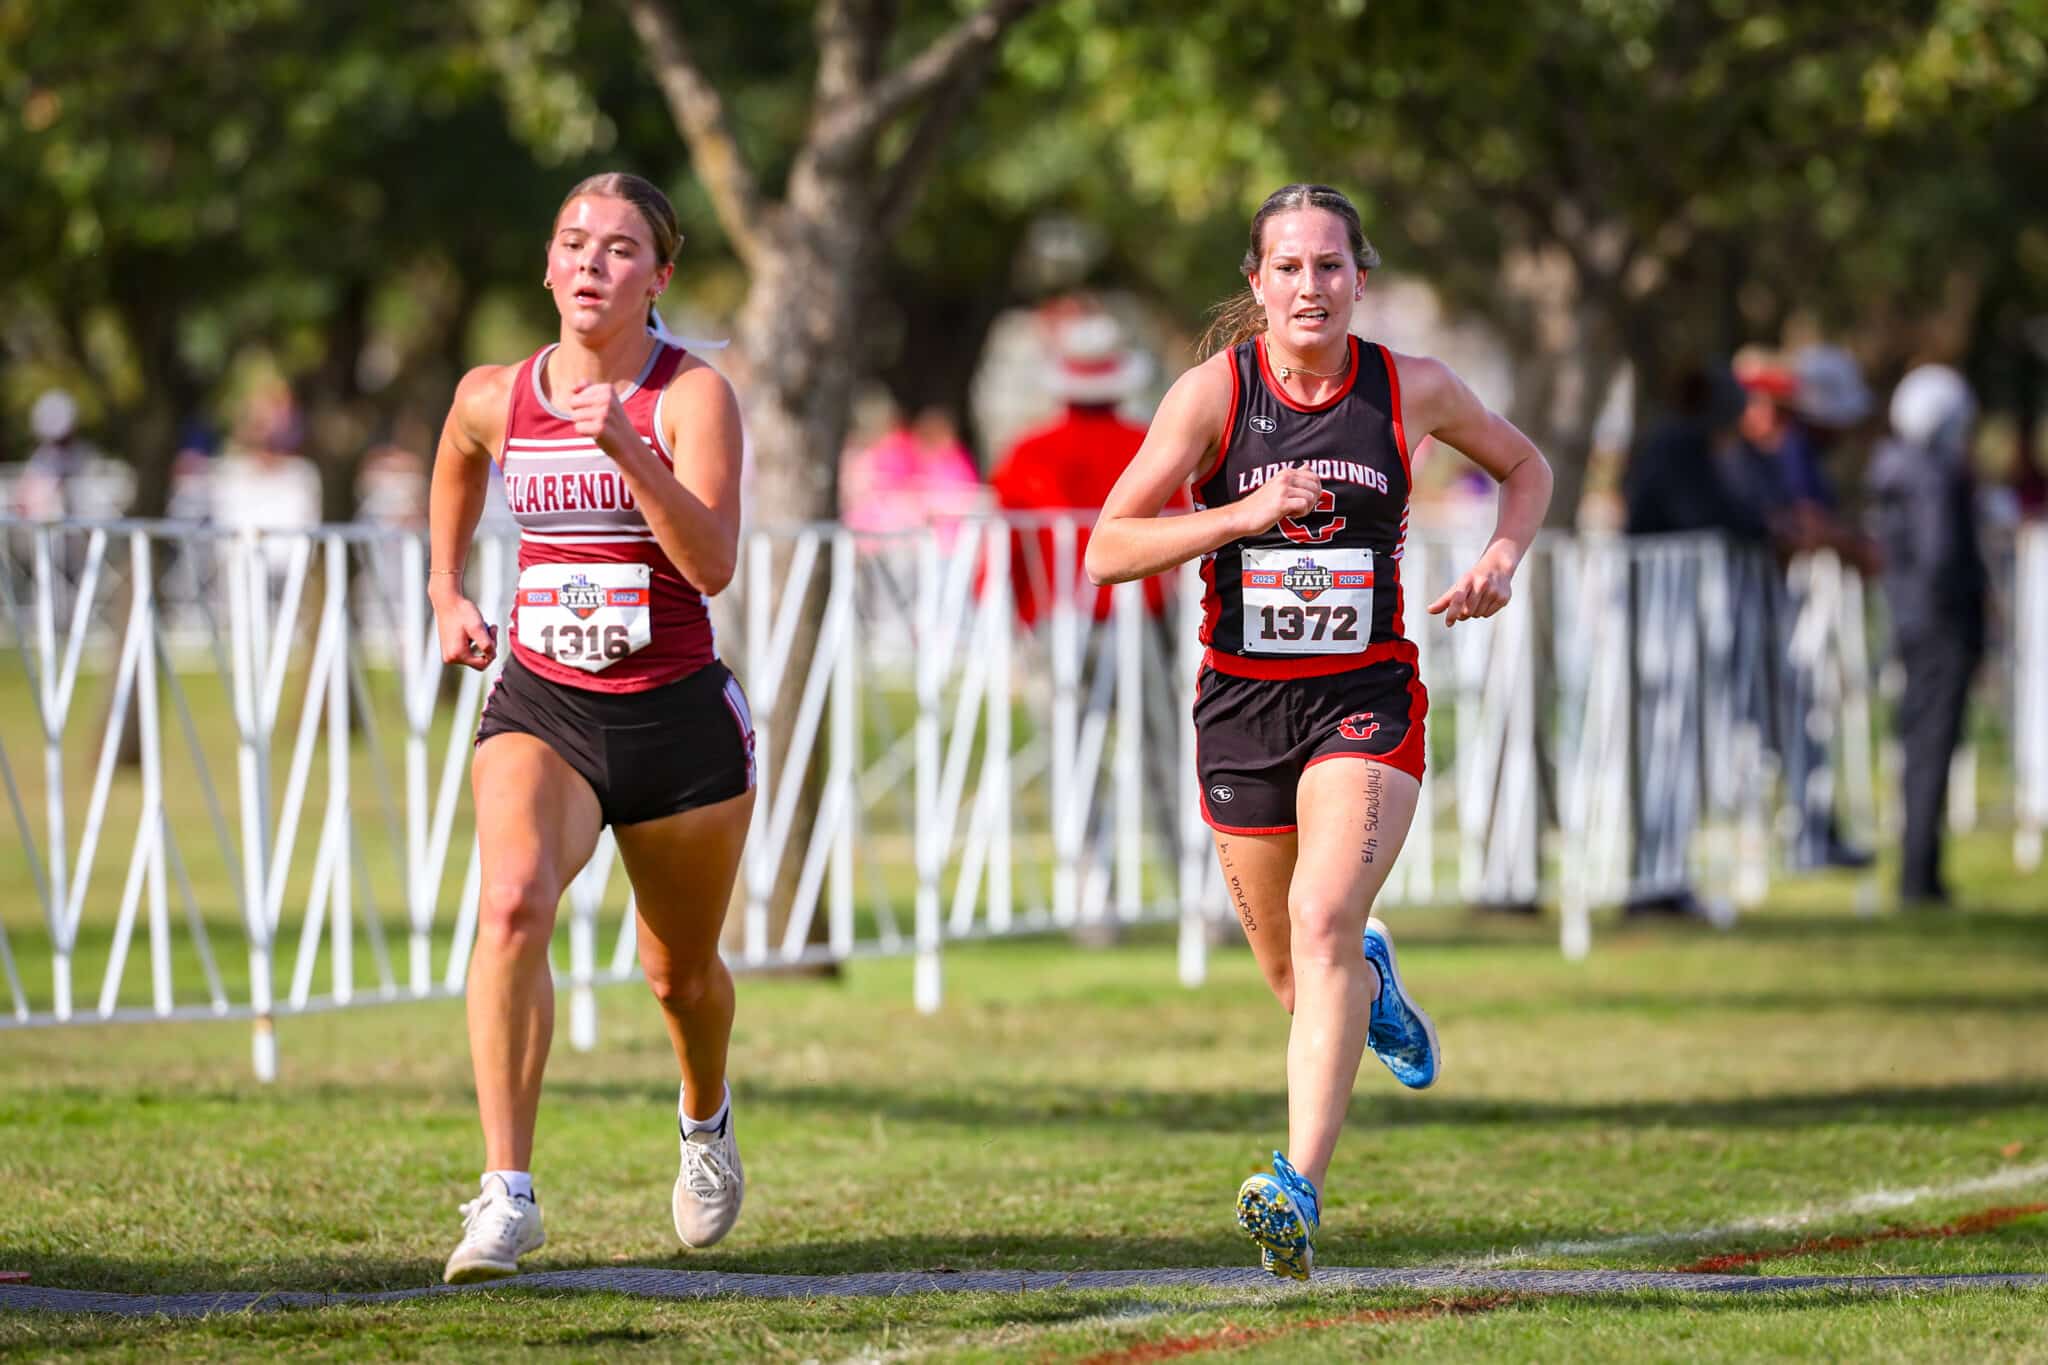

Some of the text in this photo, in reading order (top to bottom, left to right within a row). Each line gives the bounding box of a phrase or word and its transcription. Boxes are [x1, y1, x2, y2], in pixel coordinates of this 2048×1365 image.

[506, 472, 637, 513] LARENDO
[559, 591, 605, 604] STATE
[1252, 575, 1276, 584] 2025
[1283, 575, 1332, 586] STATE
[1340, 575, 1364, 584] 2025
[1260, 605, 1358, 641] 1372
[540, 624, 631, 661] 1316
[1361, 767, 1382, 864] Philippians 4:13
[1231, 876, 1257, 933] Joshua
